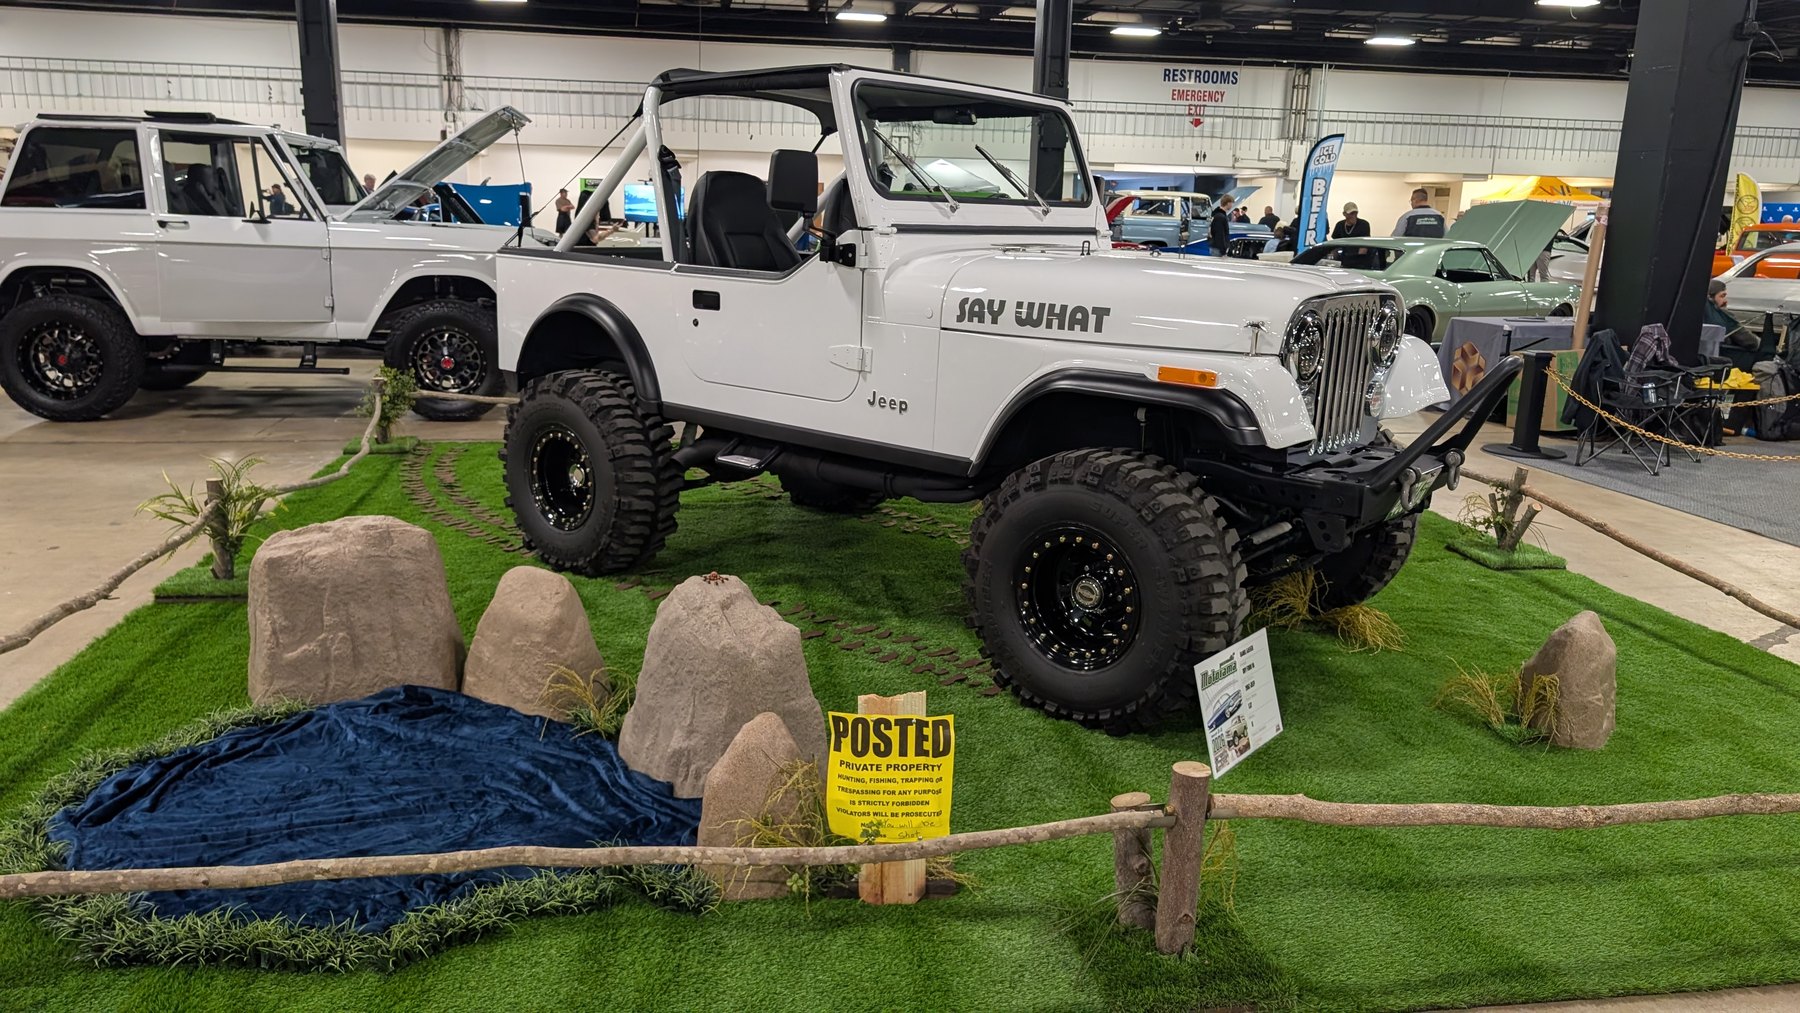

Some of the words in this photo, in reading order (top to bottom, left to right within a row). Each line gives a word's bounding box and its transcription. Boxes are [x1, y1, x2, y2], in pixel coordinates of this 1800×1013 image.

[1163, 68, 1239, 85] RESTROOMS
[1171, 89, 1225, 103] EMERGENCY
[1187, 104, 1206, 116] EXIT
[1320, 145, 1334, 156] ICE
[1314, 153, 1336, 166] COLD
[1305, 178, 1326, 247] BEER
[956, 297, 1006, 325] SAY
[1015, 301, 1111, 333] WHAT
[867, 390, 908, 415] Jeep
[1200, 660, 1238, 691] Motorama
[831, 715, 952, 758] POSTED
[839, 760, 883, 772] PRIVATE
[886, 763, 942, 772] PROPERTY
[837, 773, 868, 784] HUNTING,
[837, 785, 881, 795] TRESPASSING
[836, 807, 871, 817] VIOLATORS
